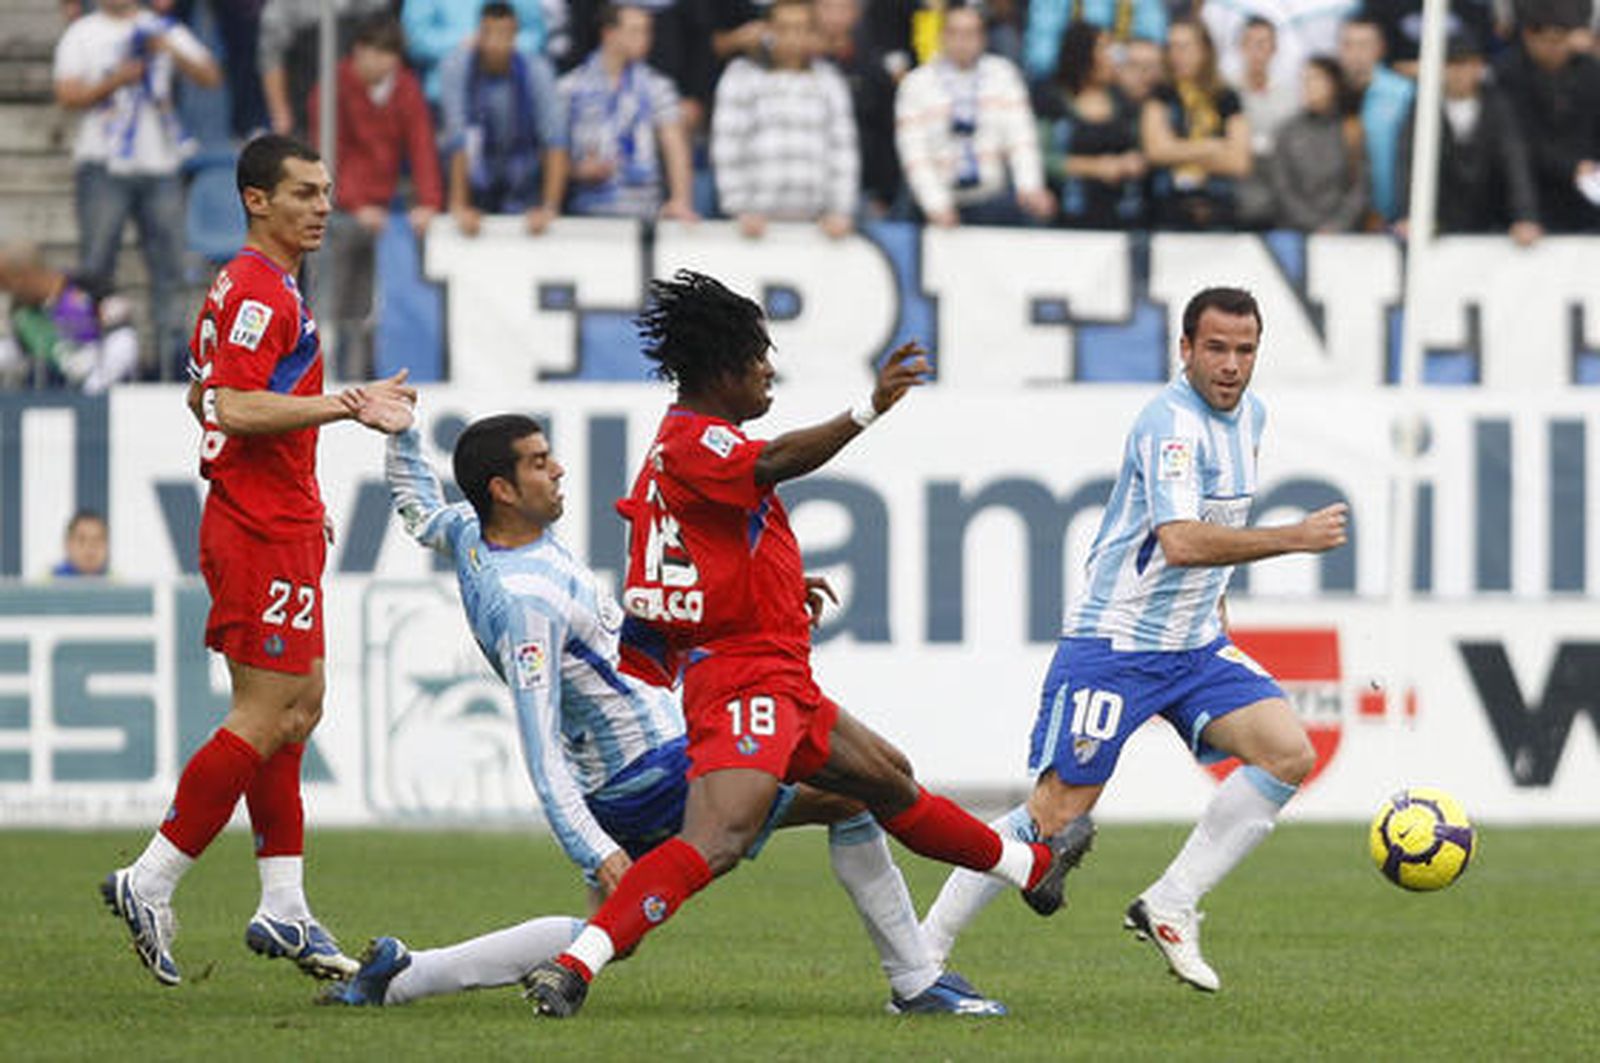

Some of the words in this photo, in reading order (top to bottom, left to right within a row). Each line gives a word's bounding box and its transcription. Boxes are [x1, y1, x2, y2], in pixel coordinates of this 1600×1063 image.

[261, 579, 315, 631] 22
[726, 695, 777, 736] 18
[1070, 687, 1124, 741] 10
